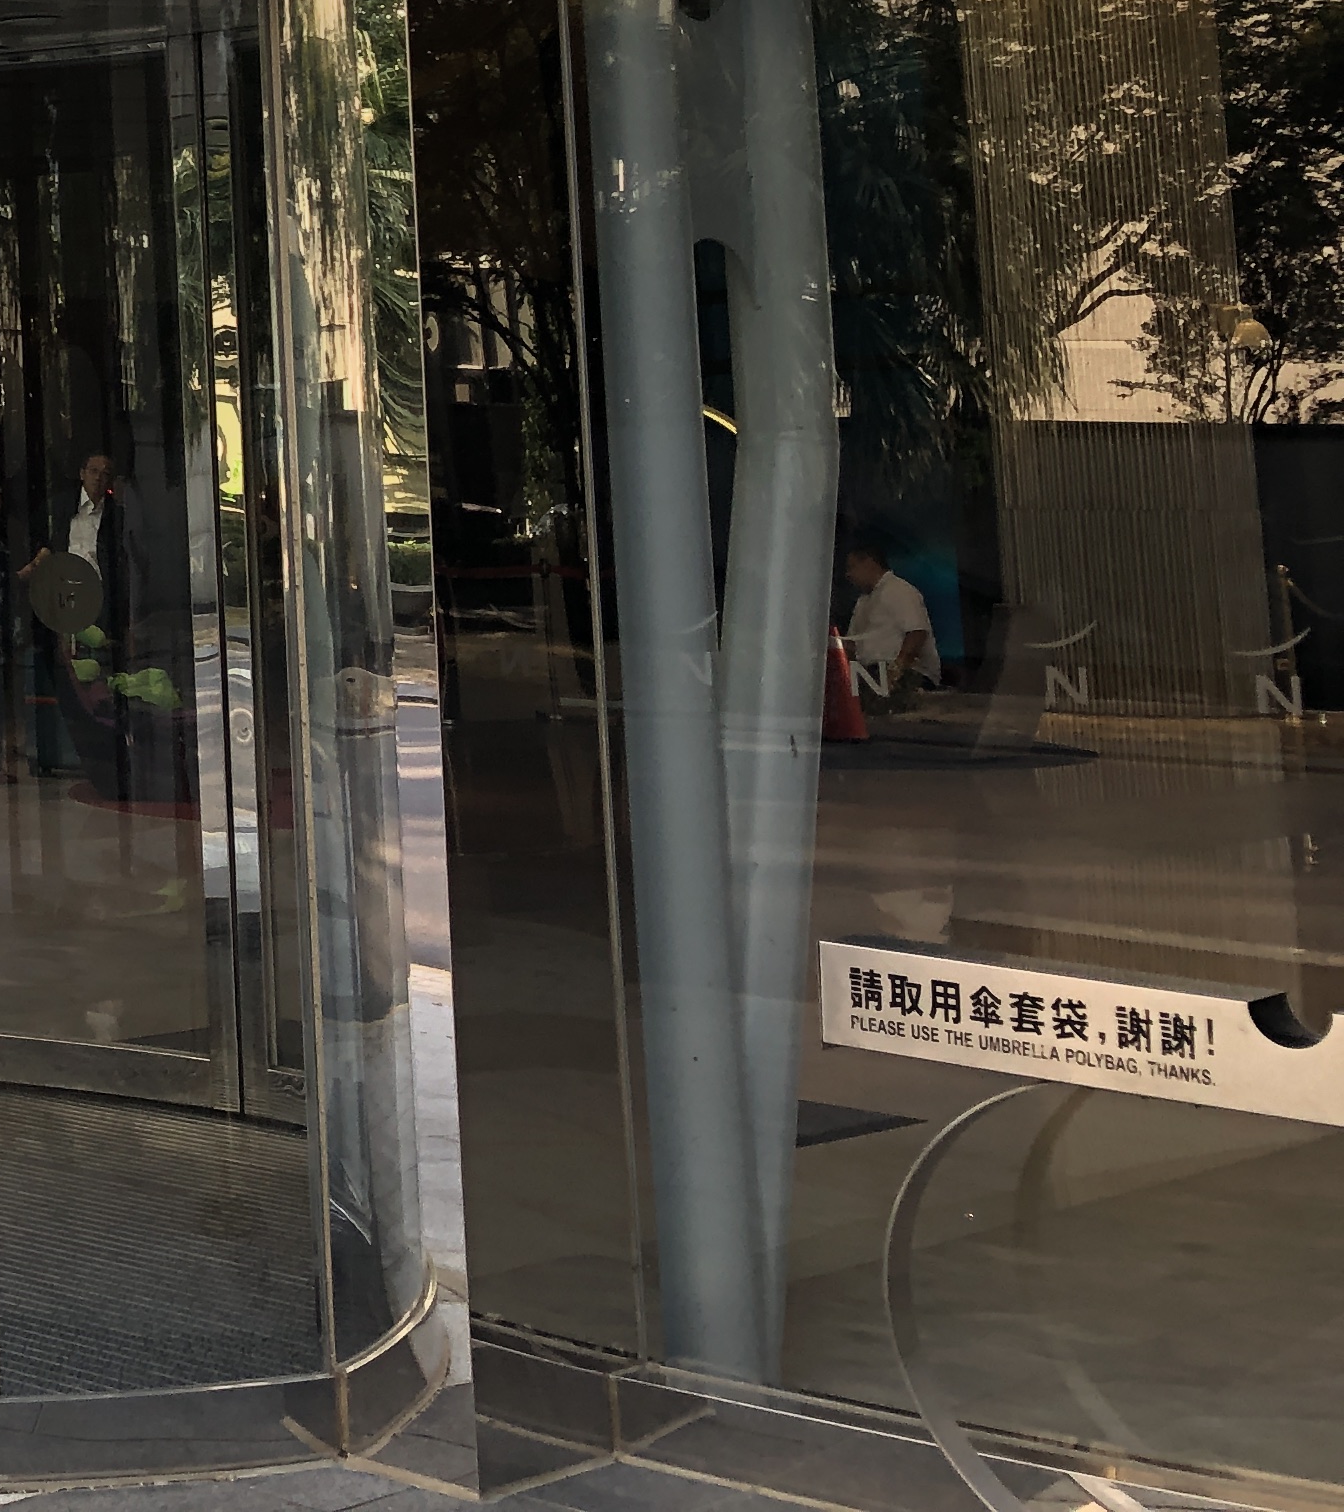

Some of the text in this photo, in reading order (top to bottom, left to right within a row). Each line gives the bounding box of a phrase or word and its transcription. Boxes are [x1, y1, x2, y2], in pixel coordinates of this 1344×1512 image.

[850, 1014, 1216, 1086] PLEASE USE THE UMBRELLA POLYBAG, THANKS.
